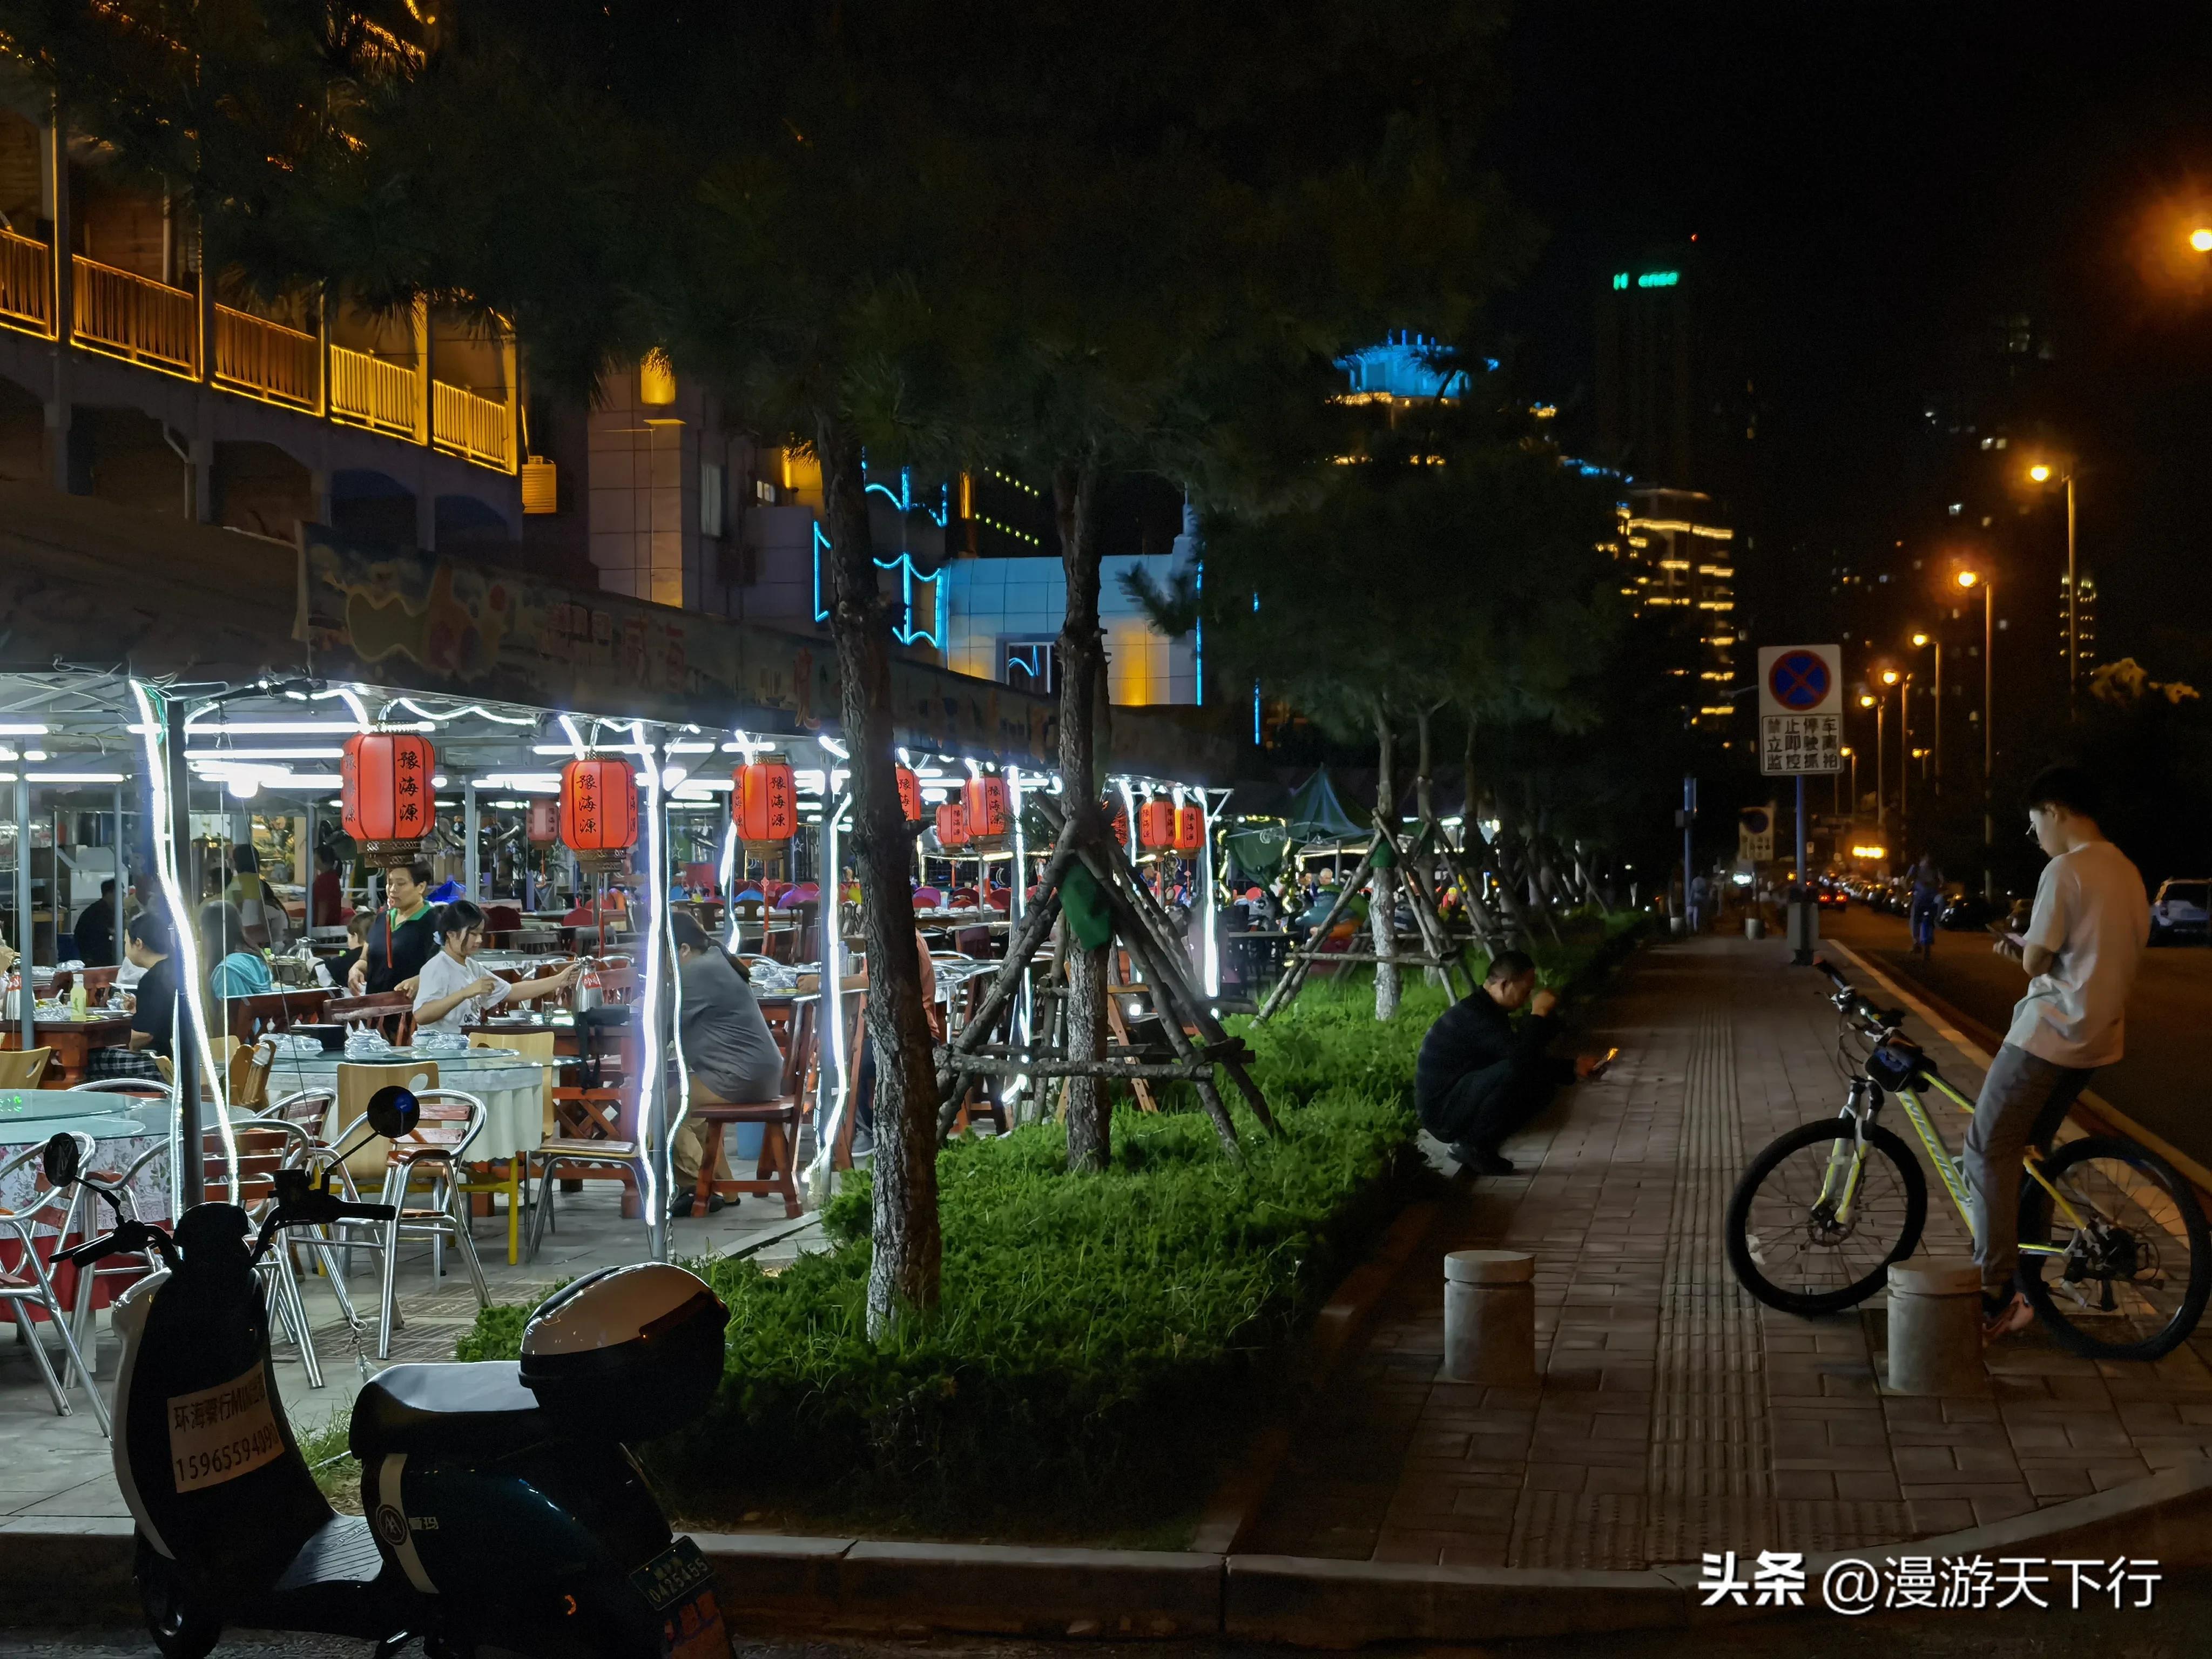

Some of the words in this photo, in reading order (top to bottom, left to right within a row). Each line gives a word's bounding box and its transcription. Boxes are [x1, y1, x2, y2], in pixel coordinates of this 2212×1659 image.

[1768, 718, 1837, 735] 禁止停车
[397, 751, 420, 821] 豫海源
[576, 774, 597, 833] 豫海源
[770, 776, 786, 826] 豫海源
